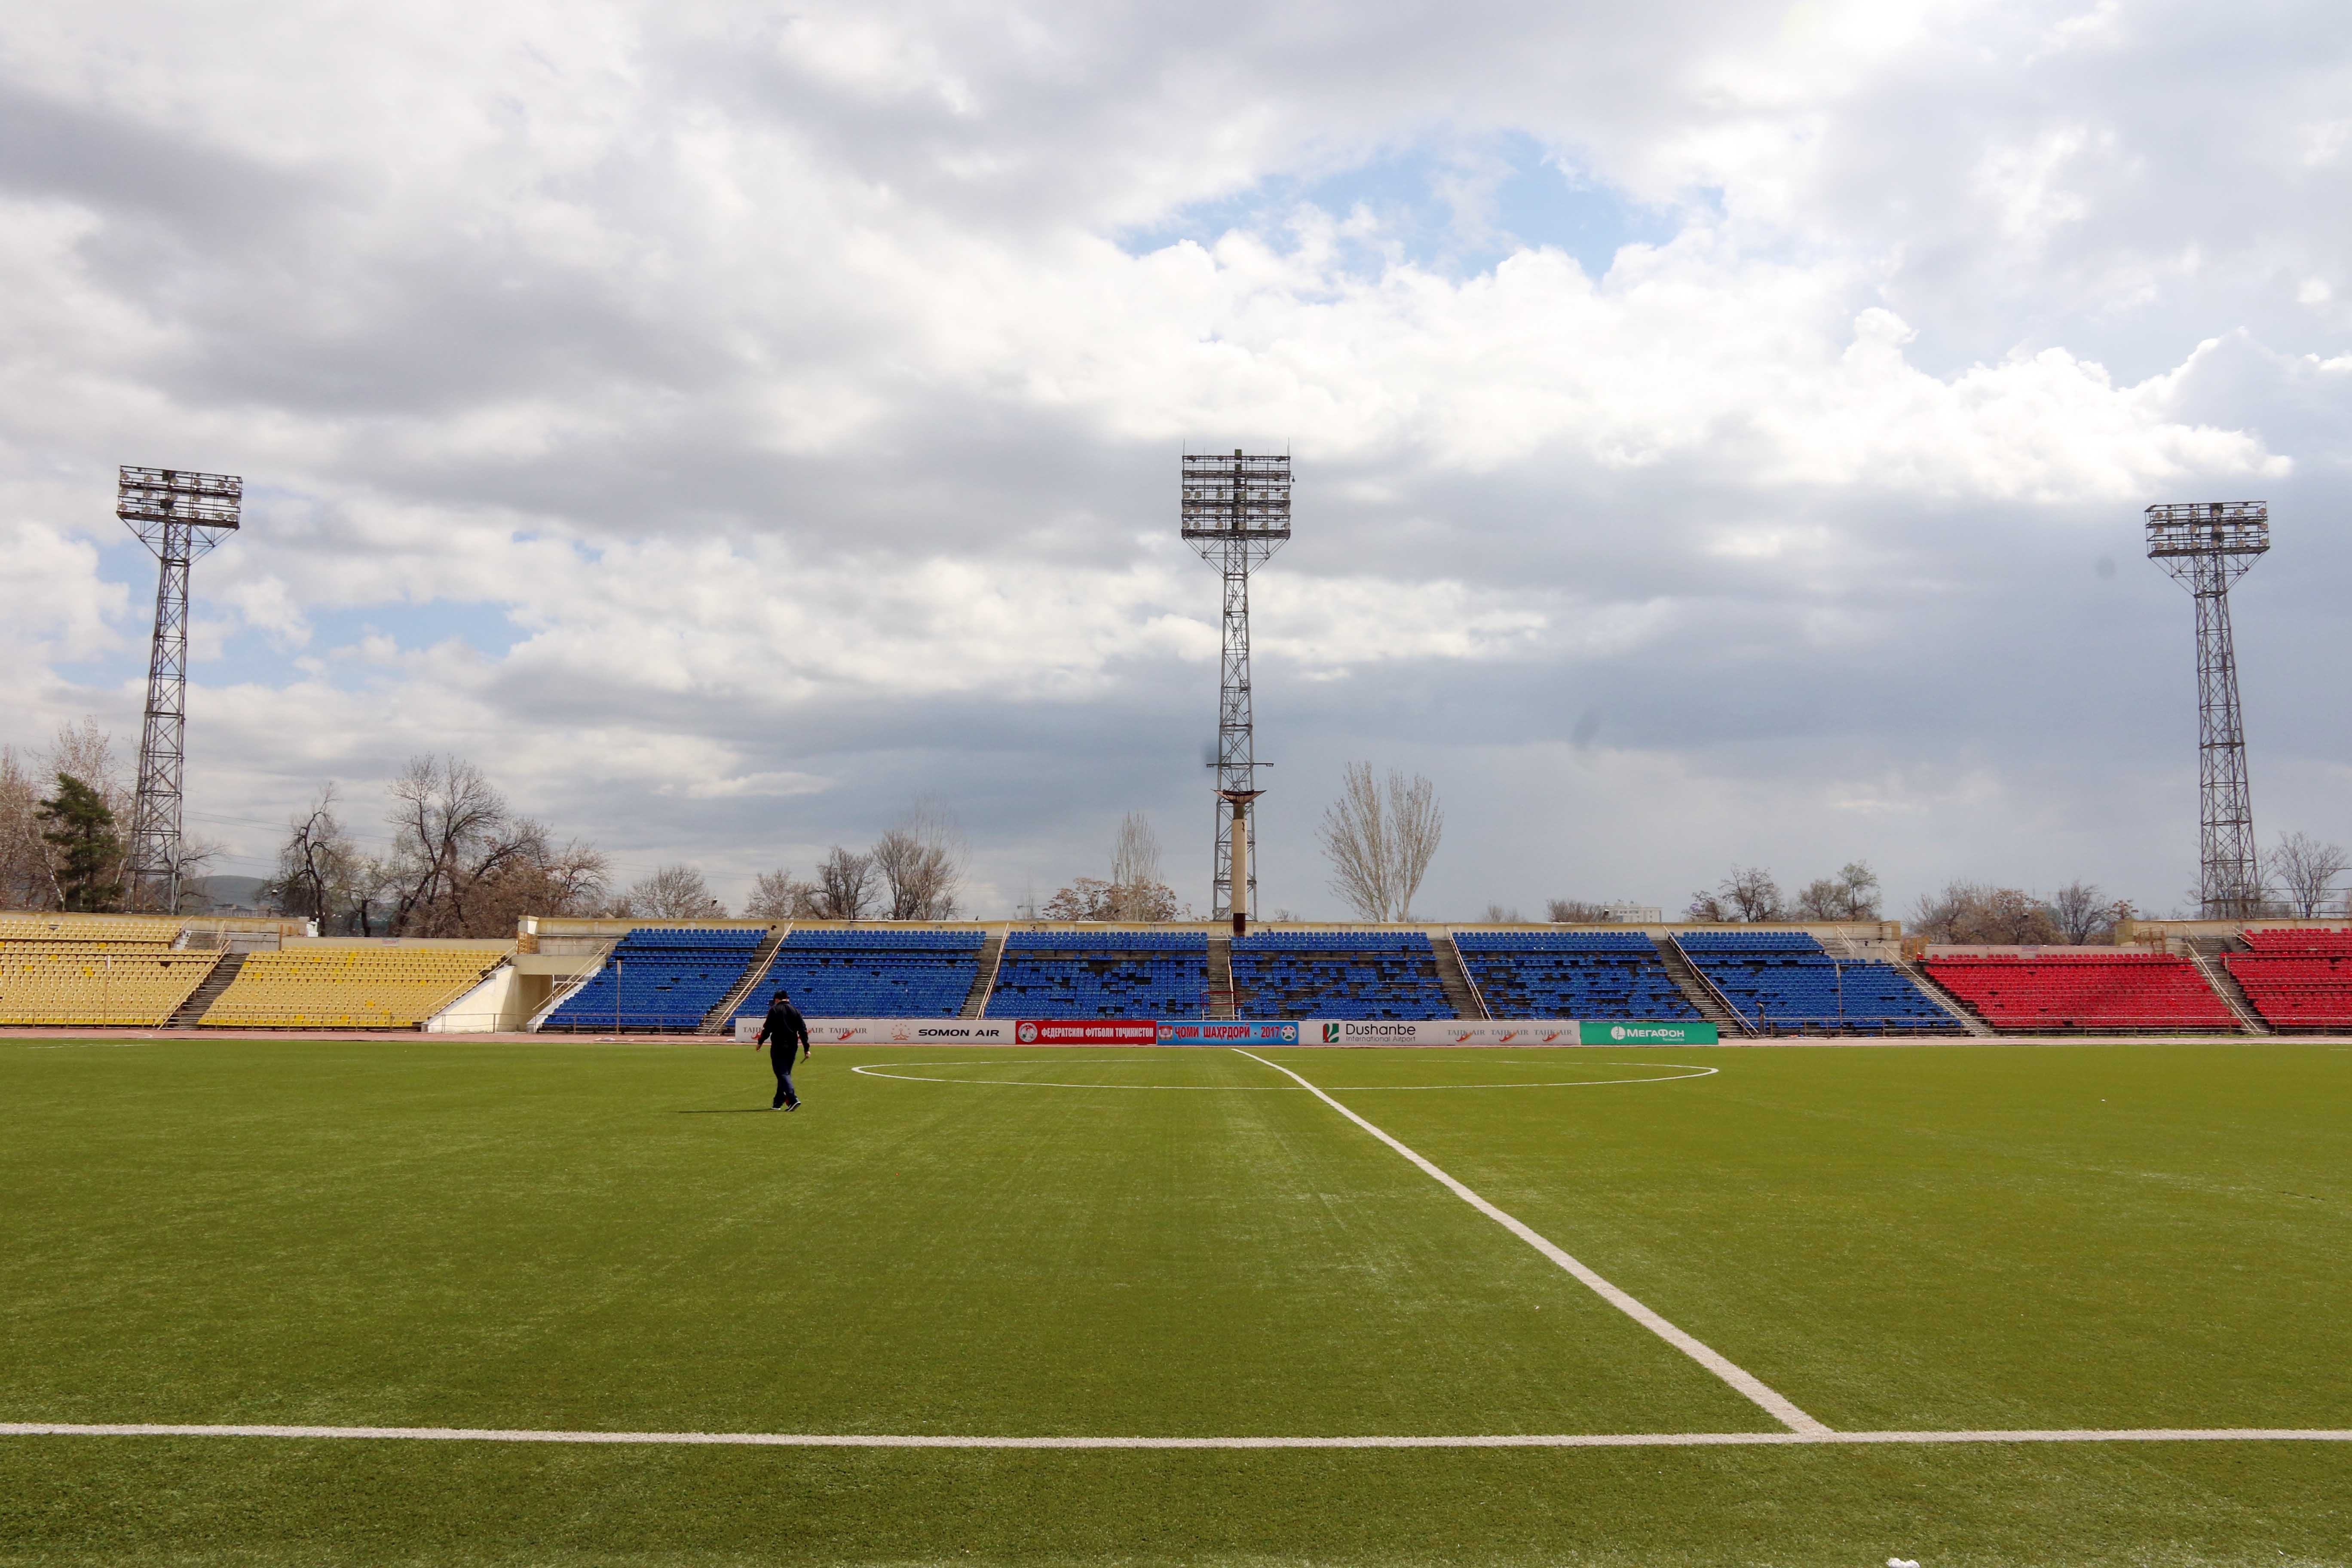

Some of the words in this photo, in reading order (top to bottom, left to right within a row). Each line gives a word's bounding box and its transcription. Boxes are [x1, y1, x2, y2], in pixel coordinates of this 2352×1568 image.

[1085, 1027, 1114, 1037] ФУТБОЛИ
[1261, 1026, 1280, 1038] 2017
[1346, 1023, 1415, 1035] Dushanbe
